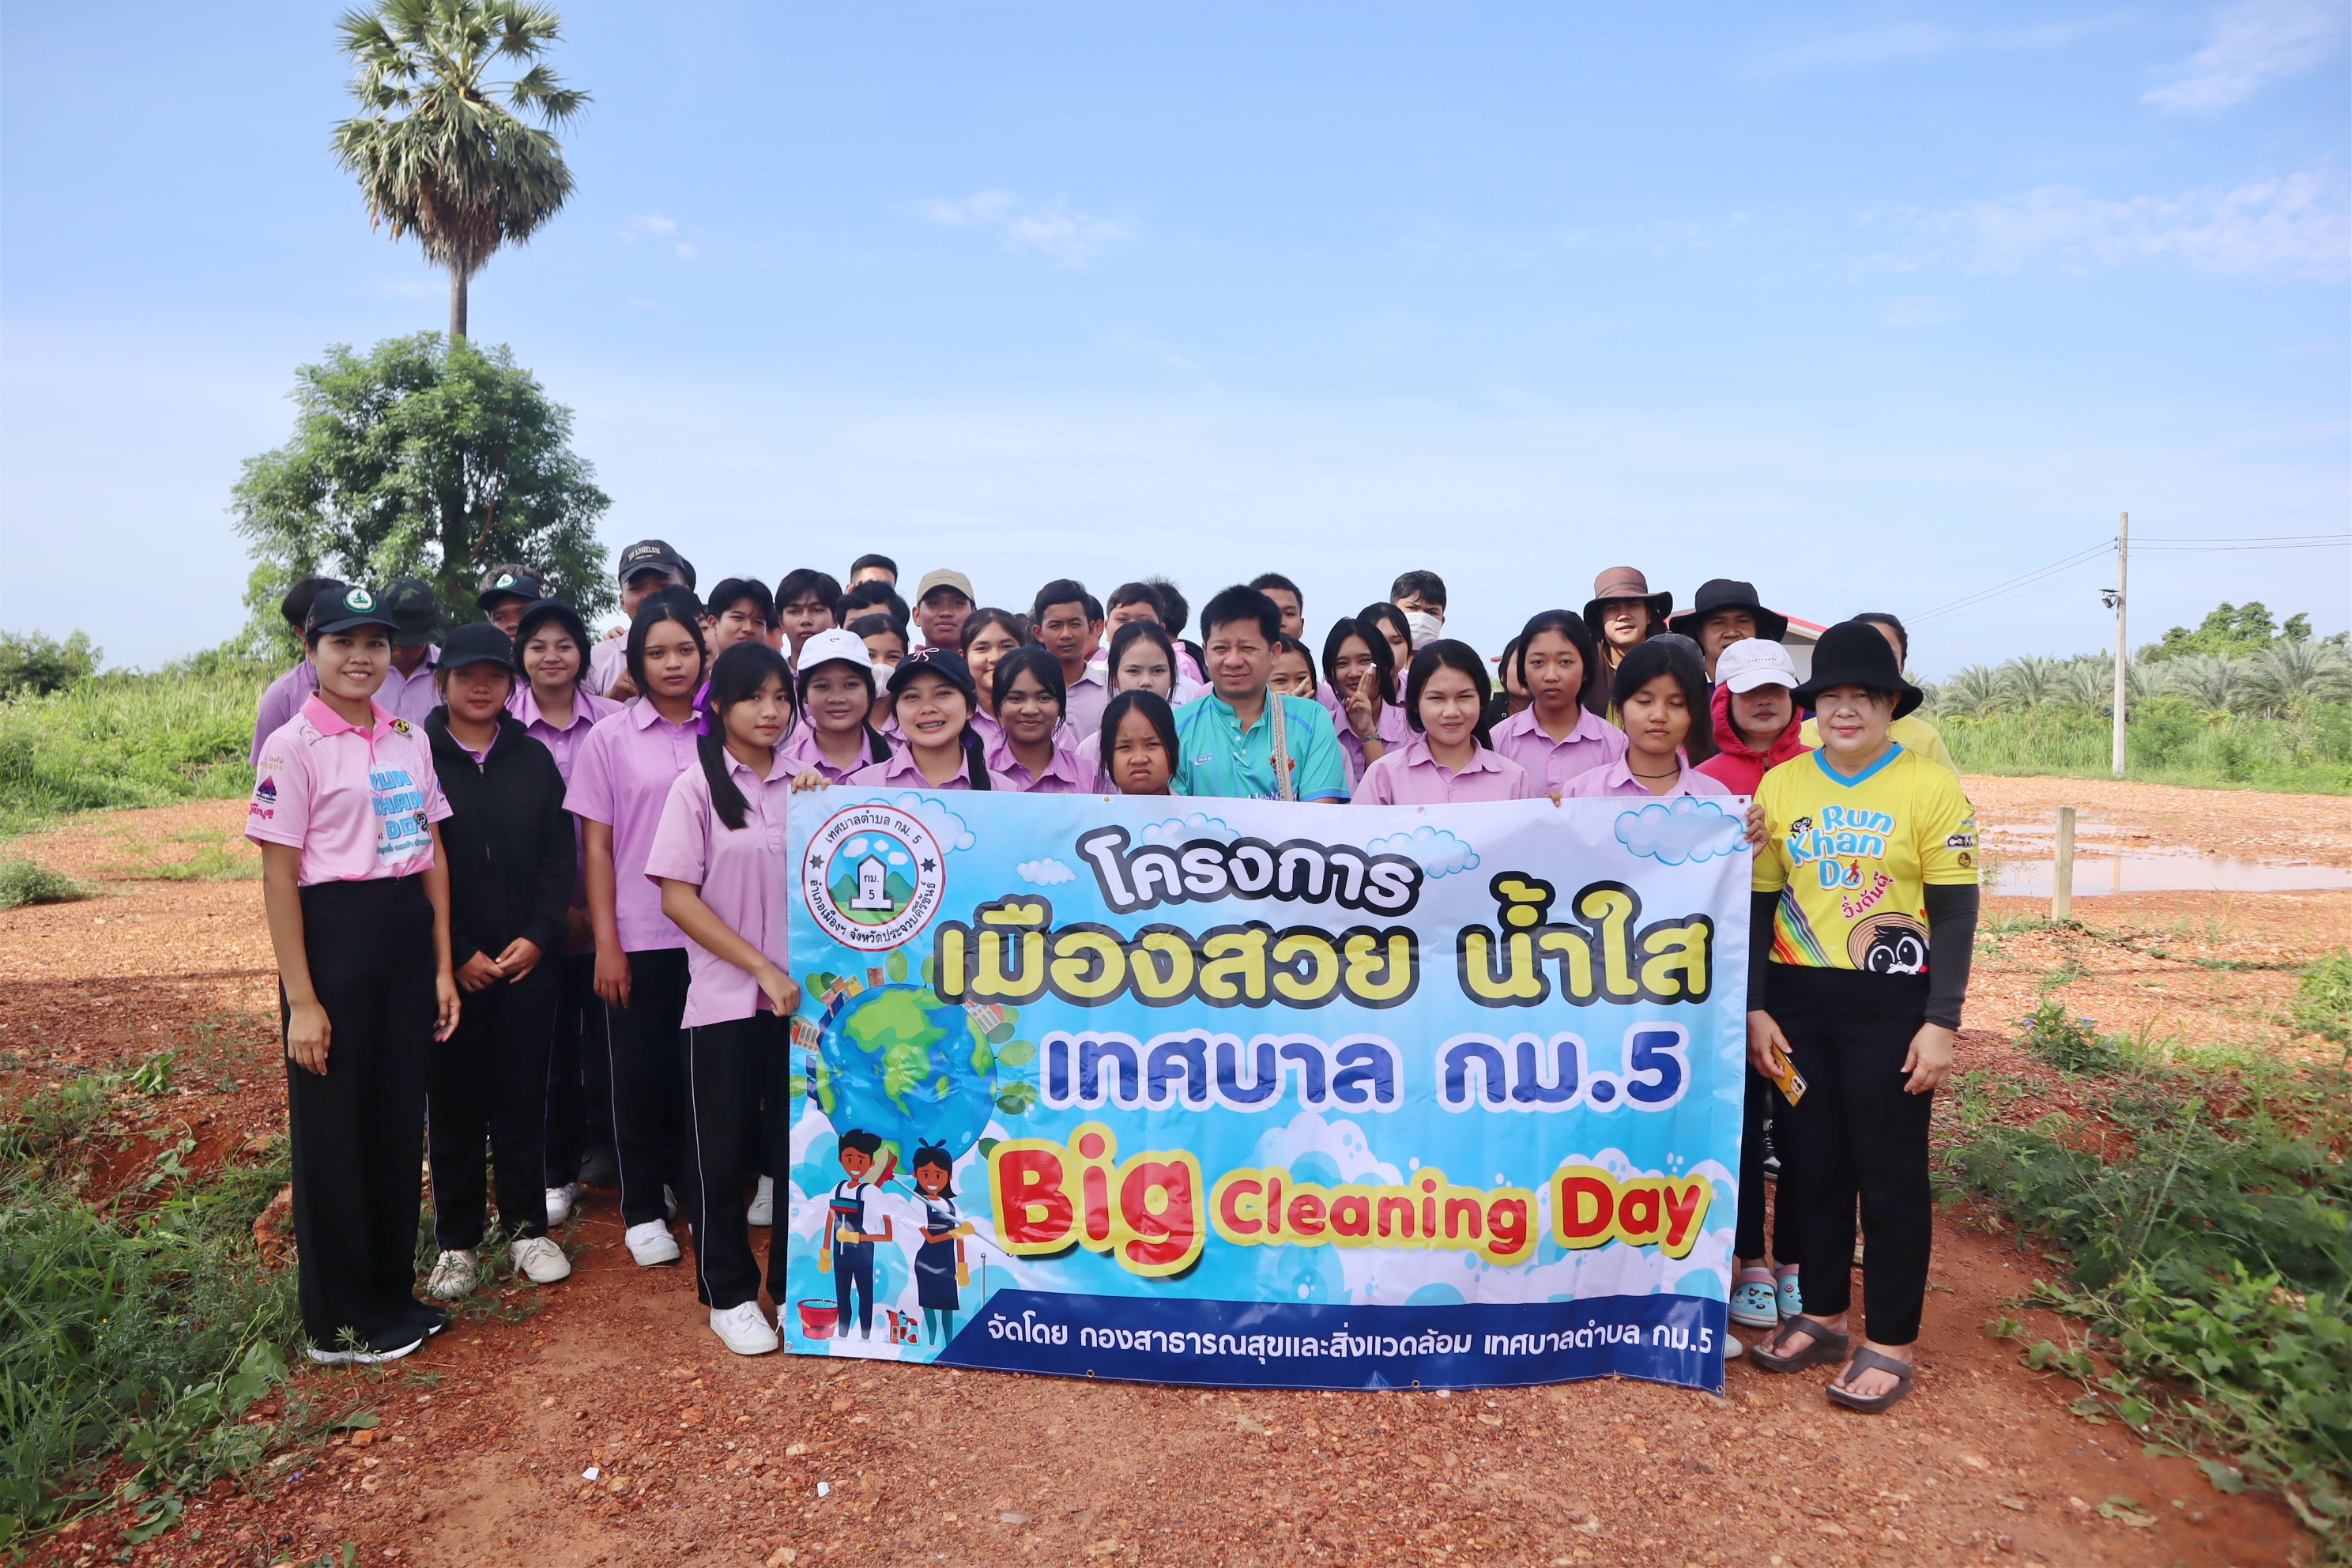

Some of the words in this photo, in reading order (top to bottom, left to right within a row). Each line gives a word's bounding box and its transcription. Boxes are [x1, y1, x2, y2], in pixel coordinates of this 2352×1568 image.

[369, 770, 413, 792] RUN
[371, 790, 425, 816] KHAN
[1820, 805, 1894, 834] Run
[385, 816, 420, 839] DO
[825, 809, 891, 844] เทศบาลตำบล
[894, 820, 910, 838] กม.
[912, 834, 923, 845] 5
[1786, 828, 1883, 865] Khan
[863, 873, 880, 884] กม.
[1084, 831, 1415, 910] โครงการ
[1819, 859, 1861, 887] Do
[809, 879, 847, 937] อำเภอเมืองฯ
[850, 880, 937, 944] จังหวัดประจวบคีรีขันธ์
[869, 888, 876, 901] 5
[941, 903, 1412, 1002] เมืองสวย
[1464, 880, 1709, 1001] น้ำใส
[1048, 1036, 1396, 1105] เทศบาล
[1444, 1029, 1681, 1105] กม.5
[997, 1132, 1194, 1265] Big
[1219, 1176, 1528, 1255] Cleaning
[1560, 1175, 1702, 1247] Day
[986, 1310, 1069, 1344] จัดโดย
[1080, 1321, 1473, 1366] กองสาธารณสุขและสิ่งแวดล้อม
[1483, 1319, 1640, 1356] เทศบาลตำบล
[1653, 1323, 1713, 1355] กม.5
